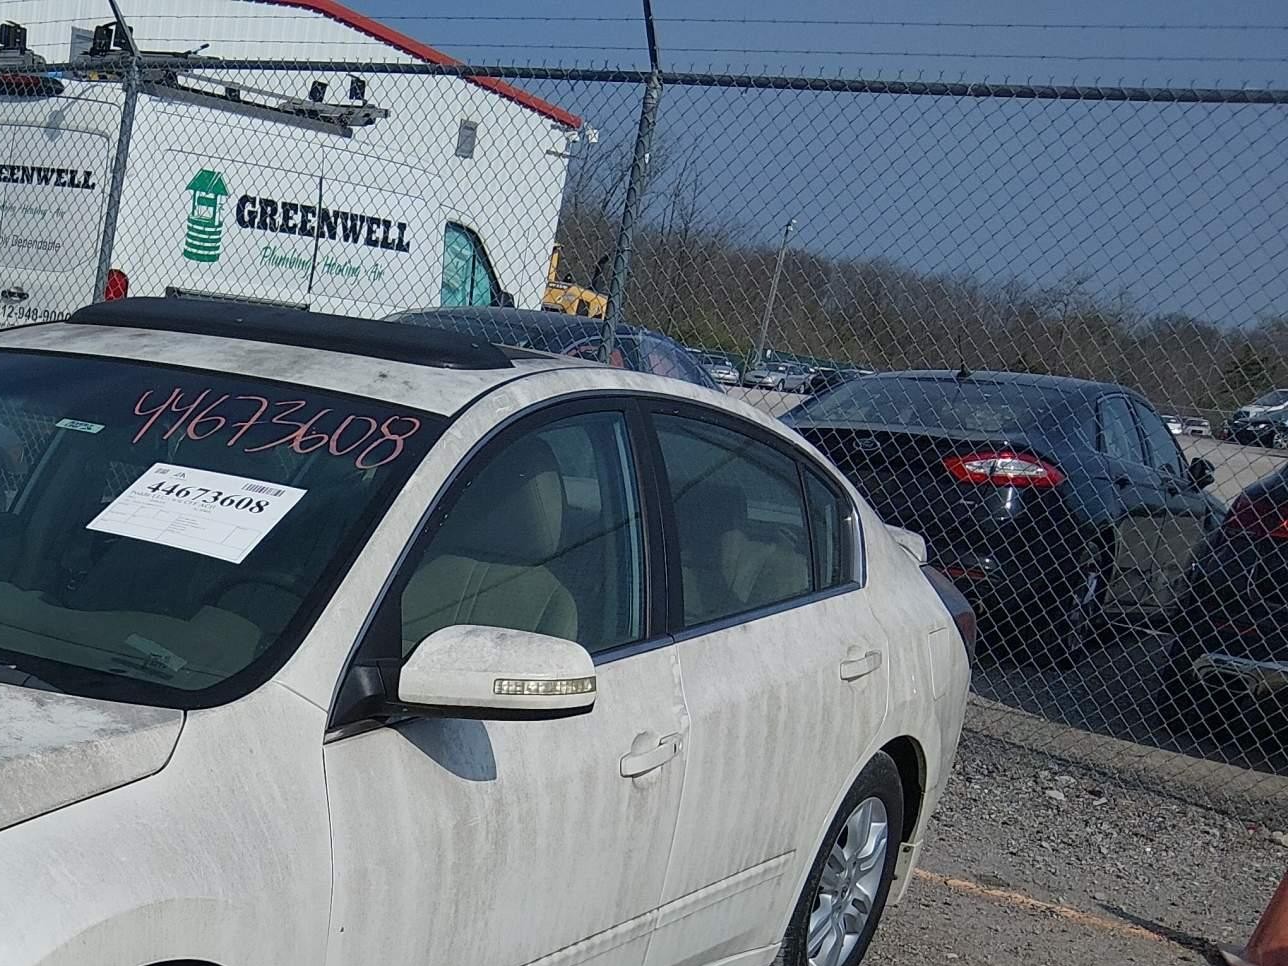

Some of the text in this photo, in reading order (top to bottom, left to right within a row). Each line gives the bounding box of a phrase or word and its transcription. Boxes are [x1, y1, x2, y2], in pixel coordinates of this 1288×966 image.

[11, 234, 61, 251] Dependable
[236, 194, 410, 253] GREENWELL
[261, 245, 384, 285] Plumbing Heating Air
[132, 387, 421, 470] 44673608
[147, 481, 270, 514] 44673608
